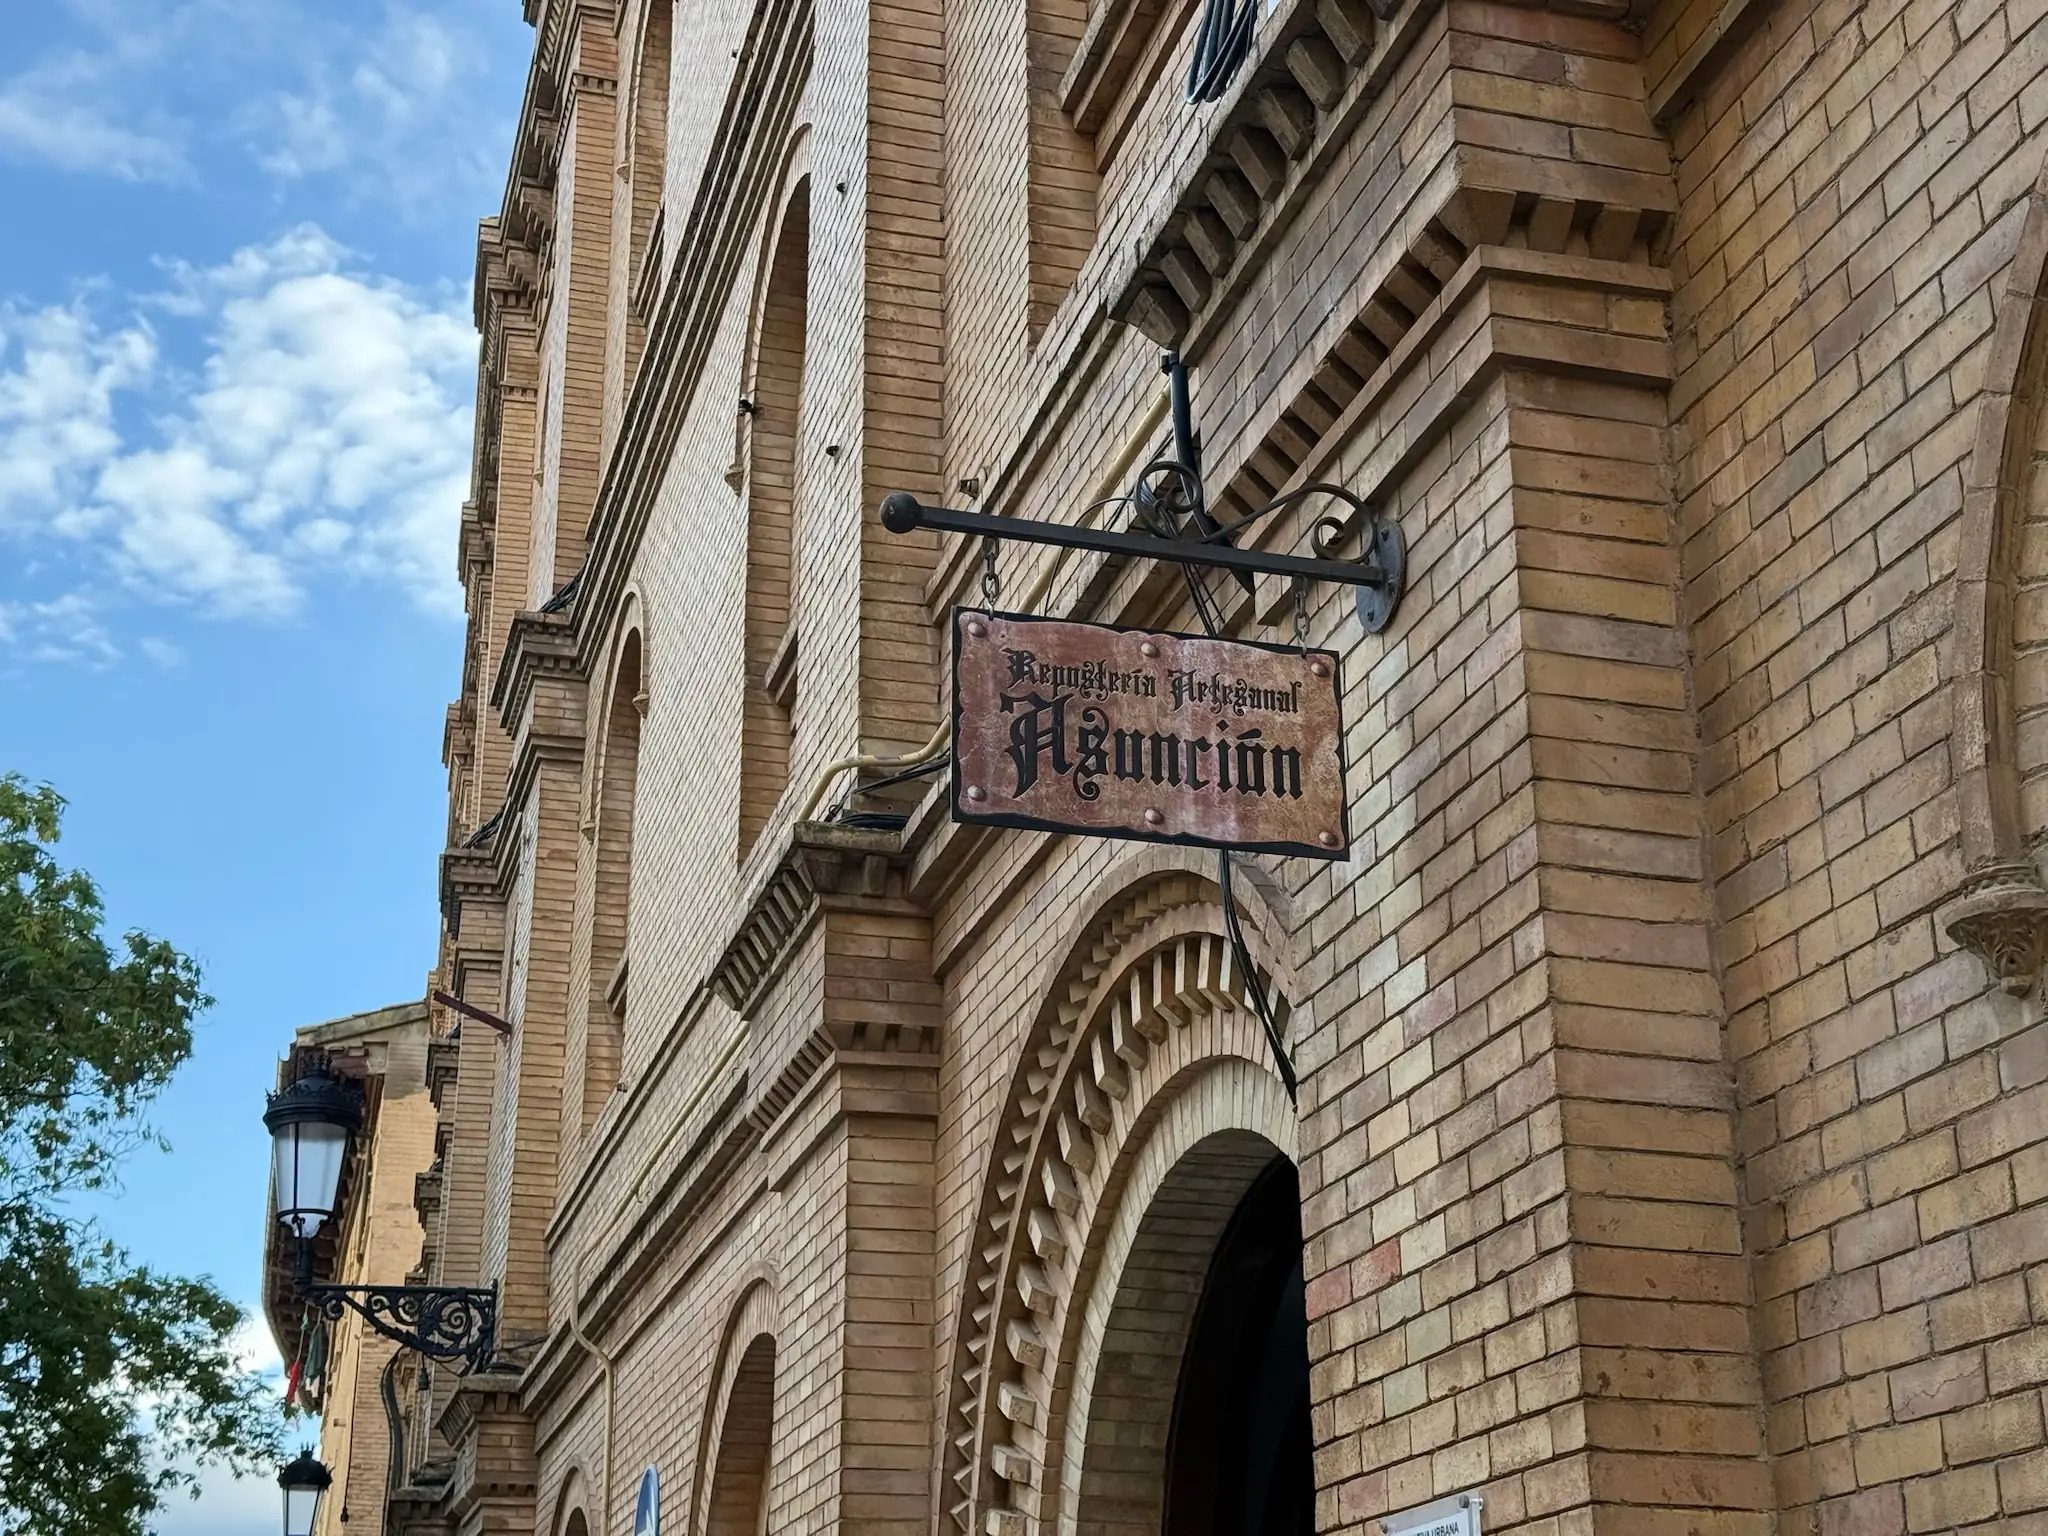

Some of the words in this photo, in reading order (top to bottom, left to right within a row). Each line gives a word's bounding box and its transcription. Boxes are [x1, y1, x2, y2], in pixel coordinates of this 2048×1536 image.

[1003, 648, 1156, 699] Repostería
[1168, 670, 1302, 715] Artesanal
[1000, 692, 1303, 800] Asunción
